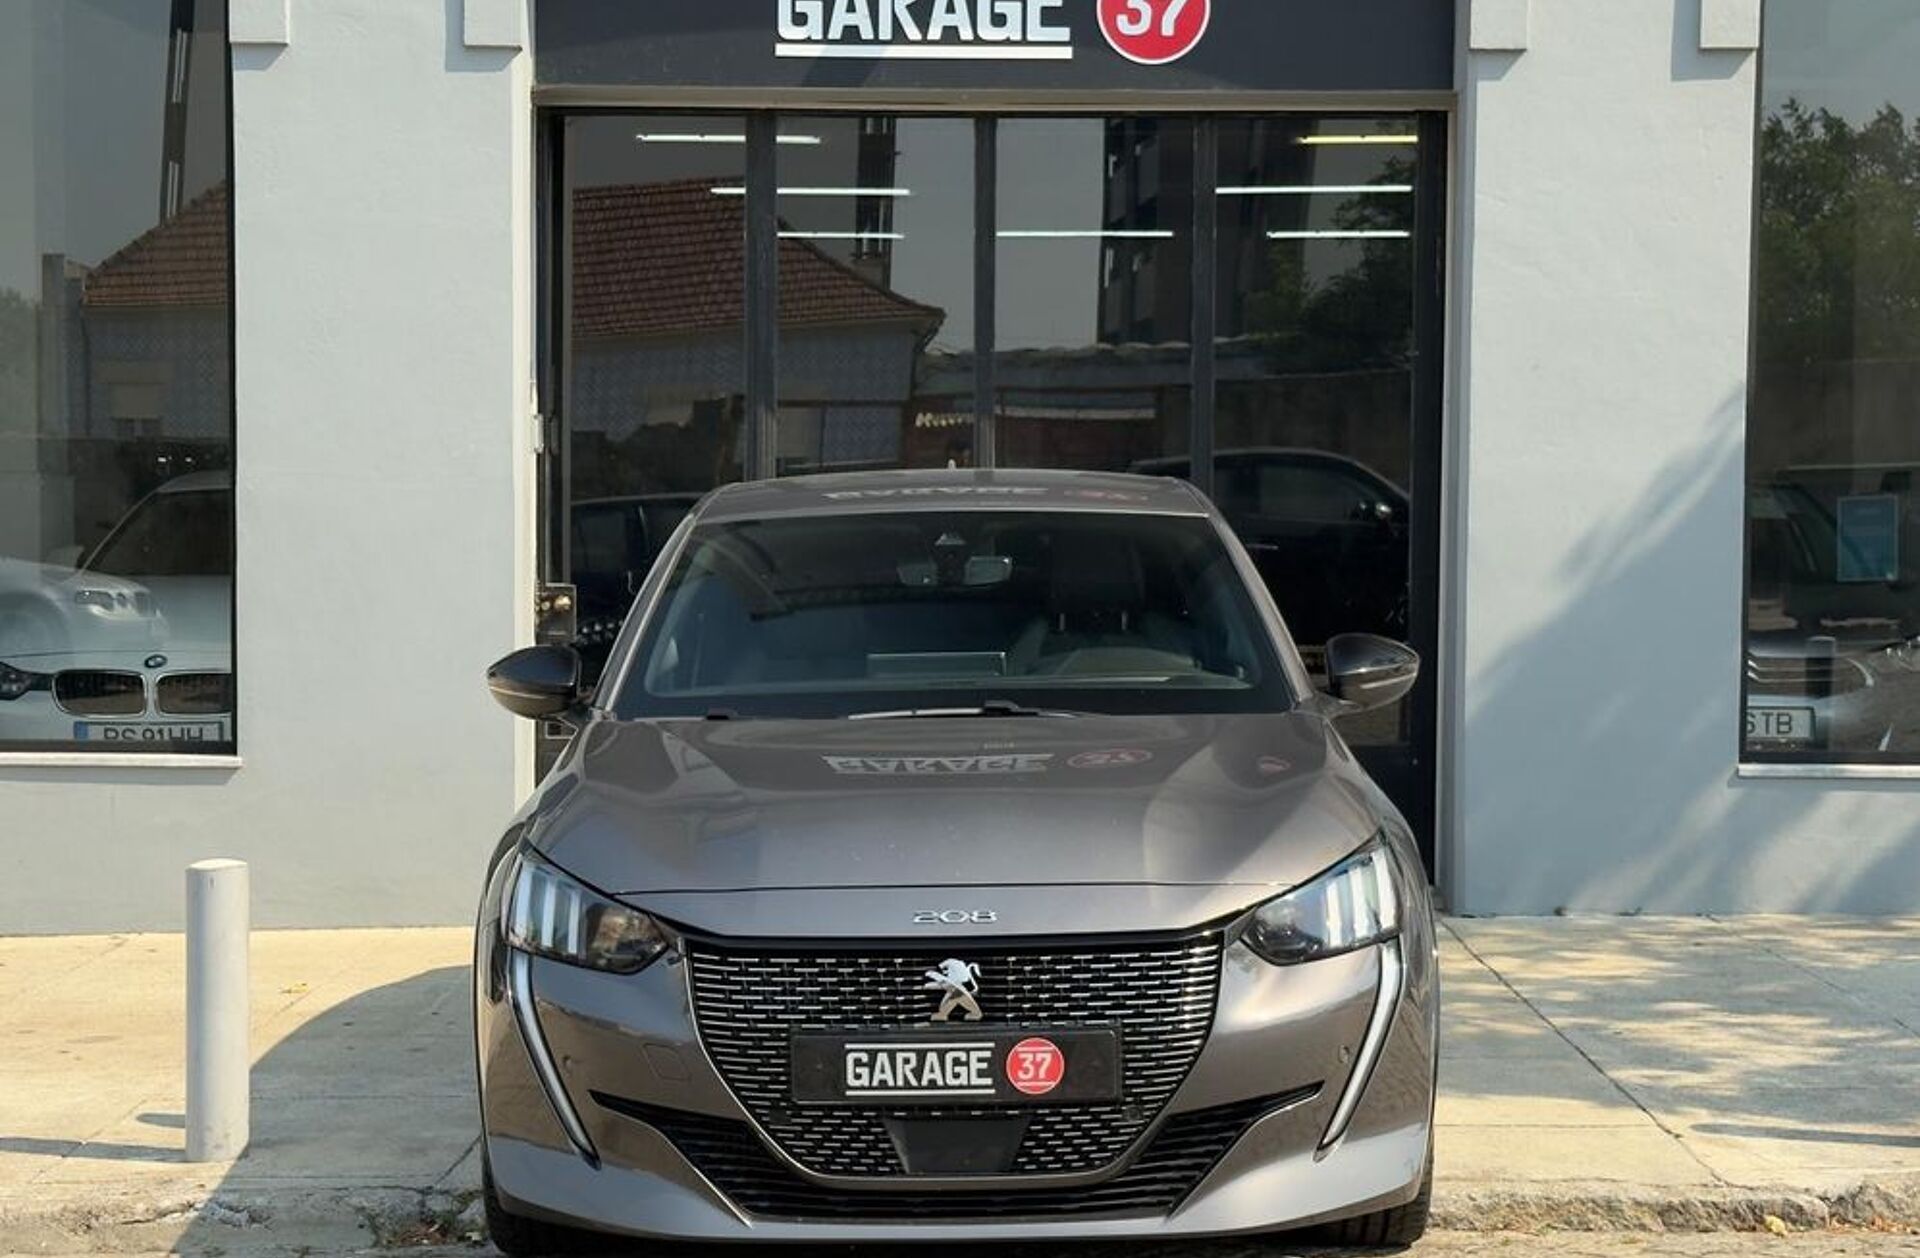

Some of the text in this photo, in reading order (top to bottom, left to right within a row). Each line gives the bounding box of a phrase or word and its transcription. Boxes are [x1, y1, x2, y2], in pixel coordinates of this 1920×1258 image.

[777, 0, 1183, 41] GARAGE 37
[913, 910, 998, 923] 208
[846, 1051, 1051, 1087] GARAGE 37
